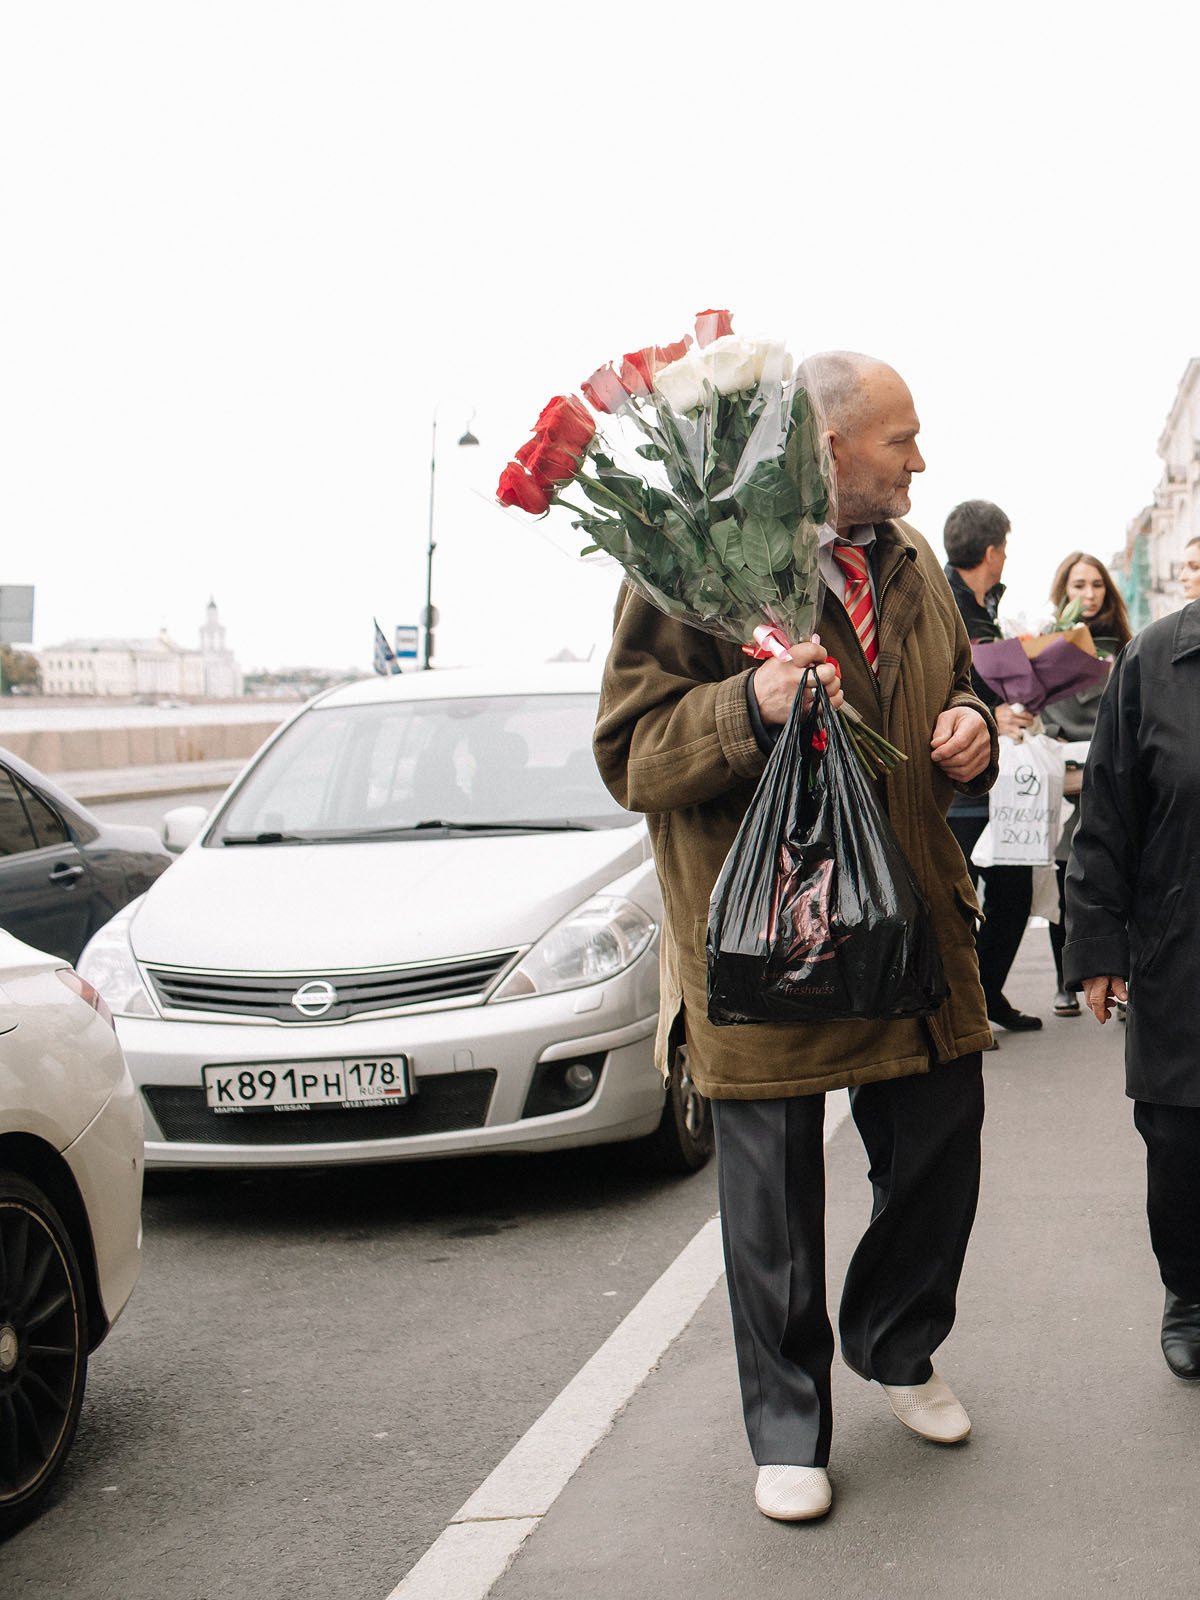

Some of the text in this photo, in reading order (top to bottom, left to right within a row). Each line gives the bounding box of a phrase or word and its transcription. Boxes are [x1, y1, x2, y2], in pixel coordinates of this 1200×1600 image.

[348, 1061, 396, 1087] 178
[359, 1086, 384, 1097] RUS
[273, 1103, 311, 1112] NISSAN
